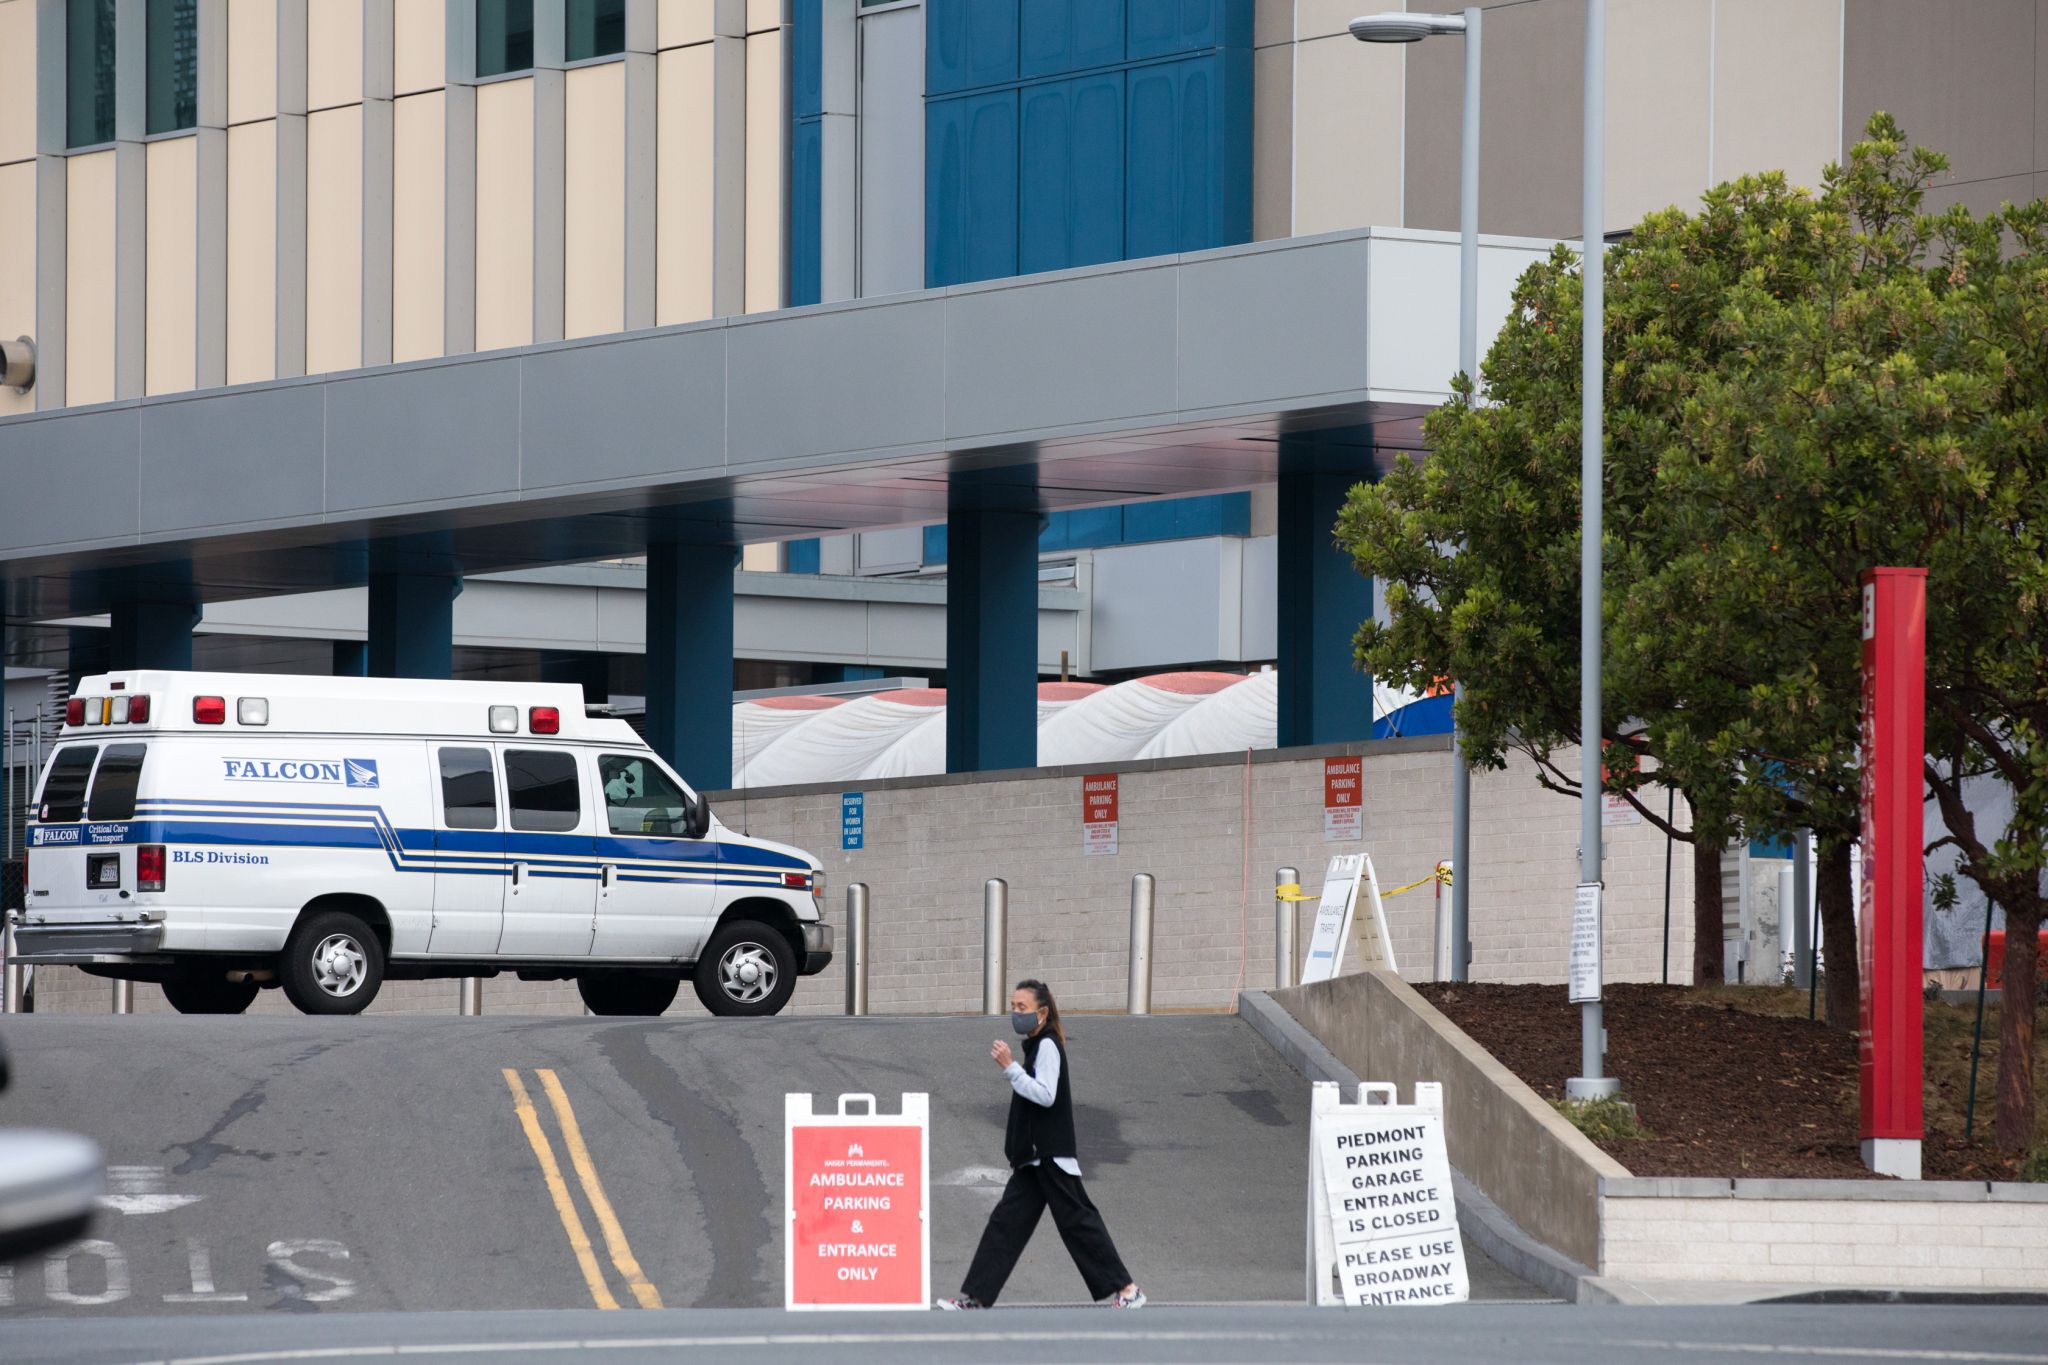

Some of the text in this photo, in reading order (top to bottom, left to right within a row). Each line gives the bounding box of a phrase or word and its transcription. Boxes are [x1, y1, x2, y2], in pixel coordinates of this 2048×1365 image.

[224, 760, 340, 780] FALCON
[1327, 764, 1360, 775] AMBULANCE
[1085, 780, 1116, 792] AMBULANCE
[1331, 778, 1355, 789] PARKING
[1090, 794, 1112, 805] PARKING
[1336, 793, 1350, 803] ONLY
[1094, 809, 1108, 819] ONLY
[44, 830, 79, 840] FALCON
[88, 825, 112, 834] Critical
[92, 834, 124, 844] Transport
[173, 851, 269, 864] BLS Division
[1337, 1126, 1426, 1149] PIEDMONT
[1346, 1148, 1423, 1169] PARKING
[810, 1173, 904, 1186] AMBULANCE
[1352, 1169, 1423, 1189] GARAGE
[824, 1197, 890, 1210] PARKING
[1344, 1188, 1439, 1212] ENTRANCE
[851, 1220, 864, 1234] &
[1349, 1209, 1440, 1232] IS CLOSED
[818, 1244, 896, 1257] ENTRANCE
[1345, 1241, 1455, 1267] PLEASE USE
[838, 1267, 878, 1280] ONLY
[1354, 1262, 1452, 1286] BROADWAY
[1360, 1283, 1455, 1306] ENTRANCE
